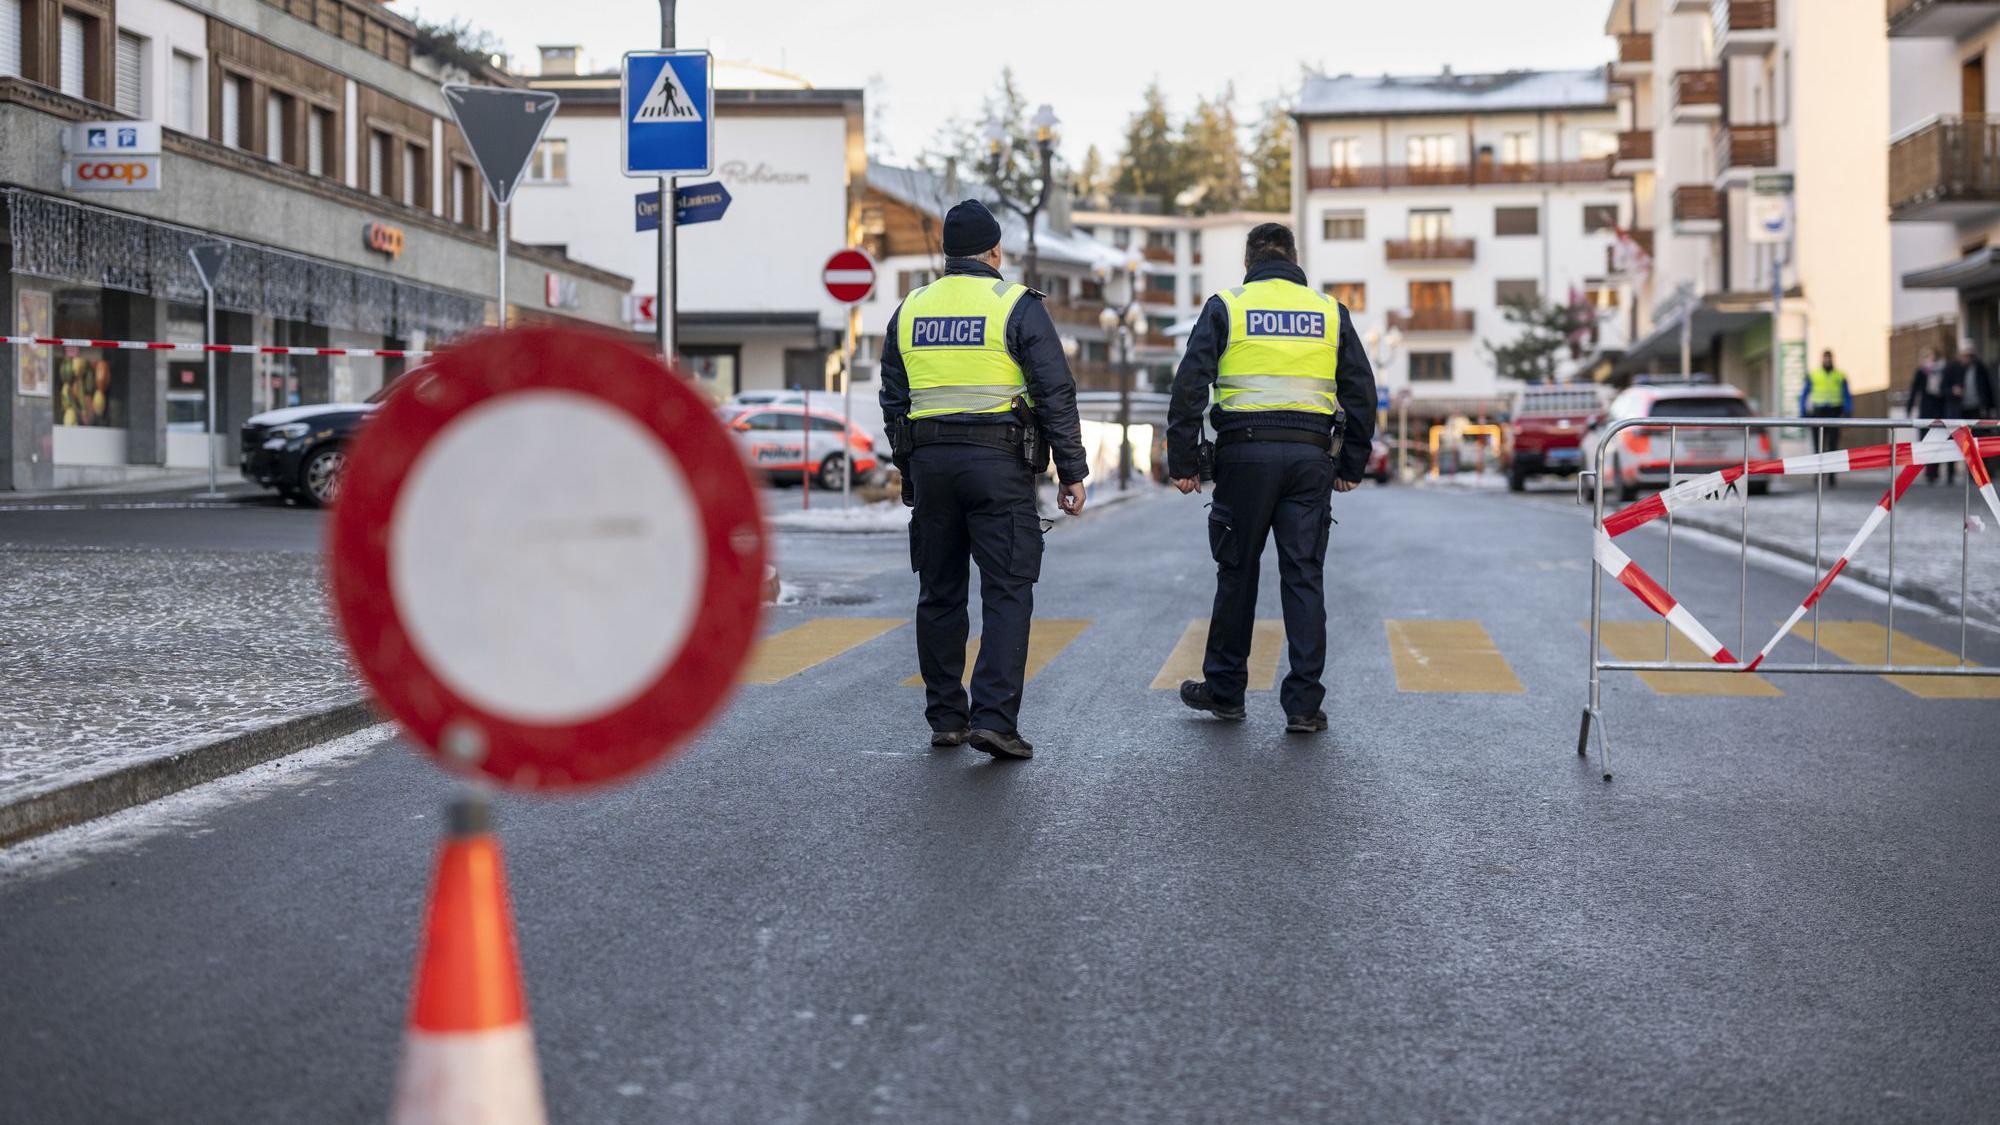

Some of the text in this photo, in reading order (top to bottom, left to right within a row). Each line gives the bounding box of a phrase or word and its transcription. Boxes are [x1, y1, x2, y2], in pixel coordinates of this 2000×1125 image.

[77, 162, 148, 185] coop
[370, 223, 405, 258] coop
[914, 320, 982, 343] POLICE
[1249, 312, 1322, 334] POLICE
